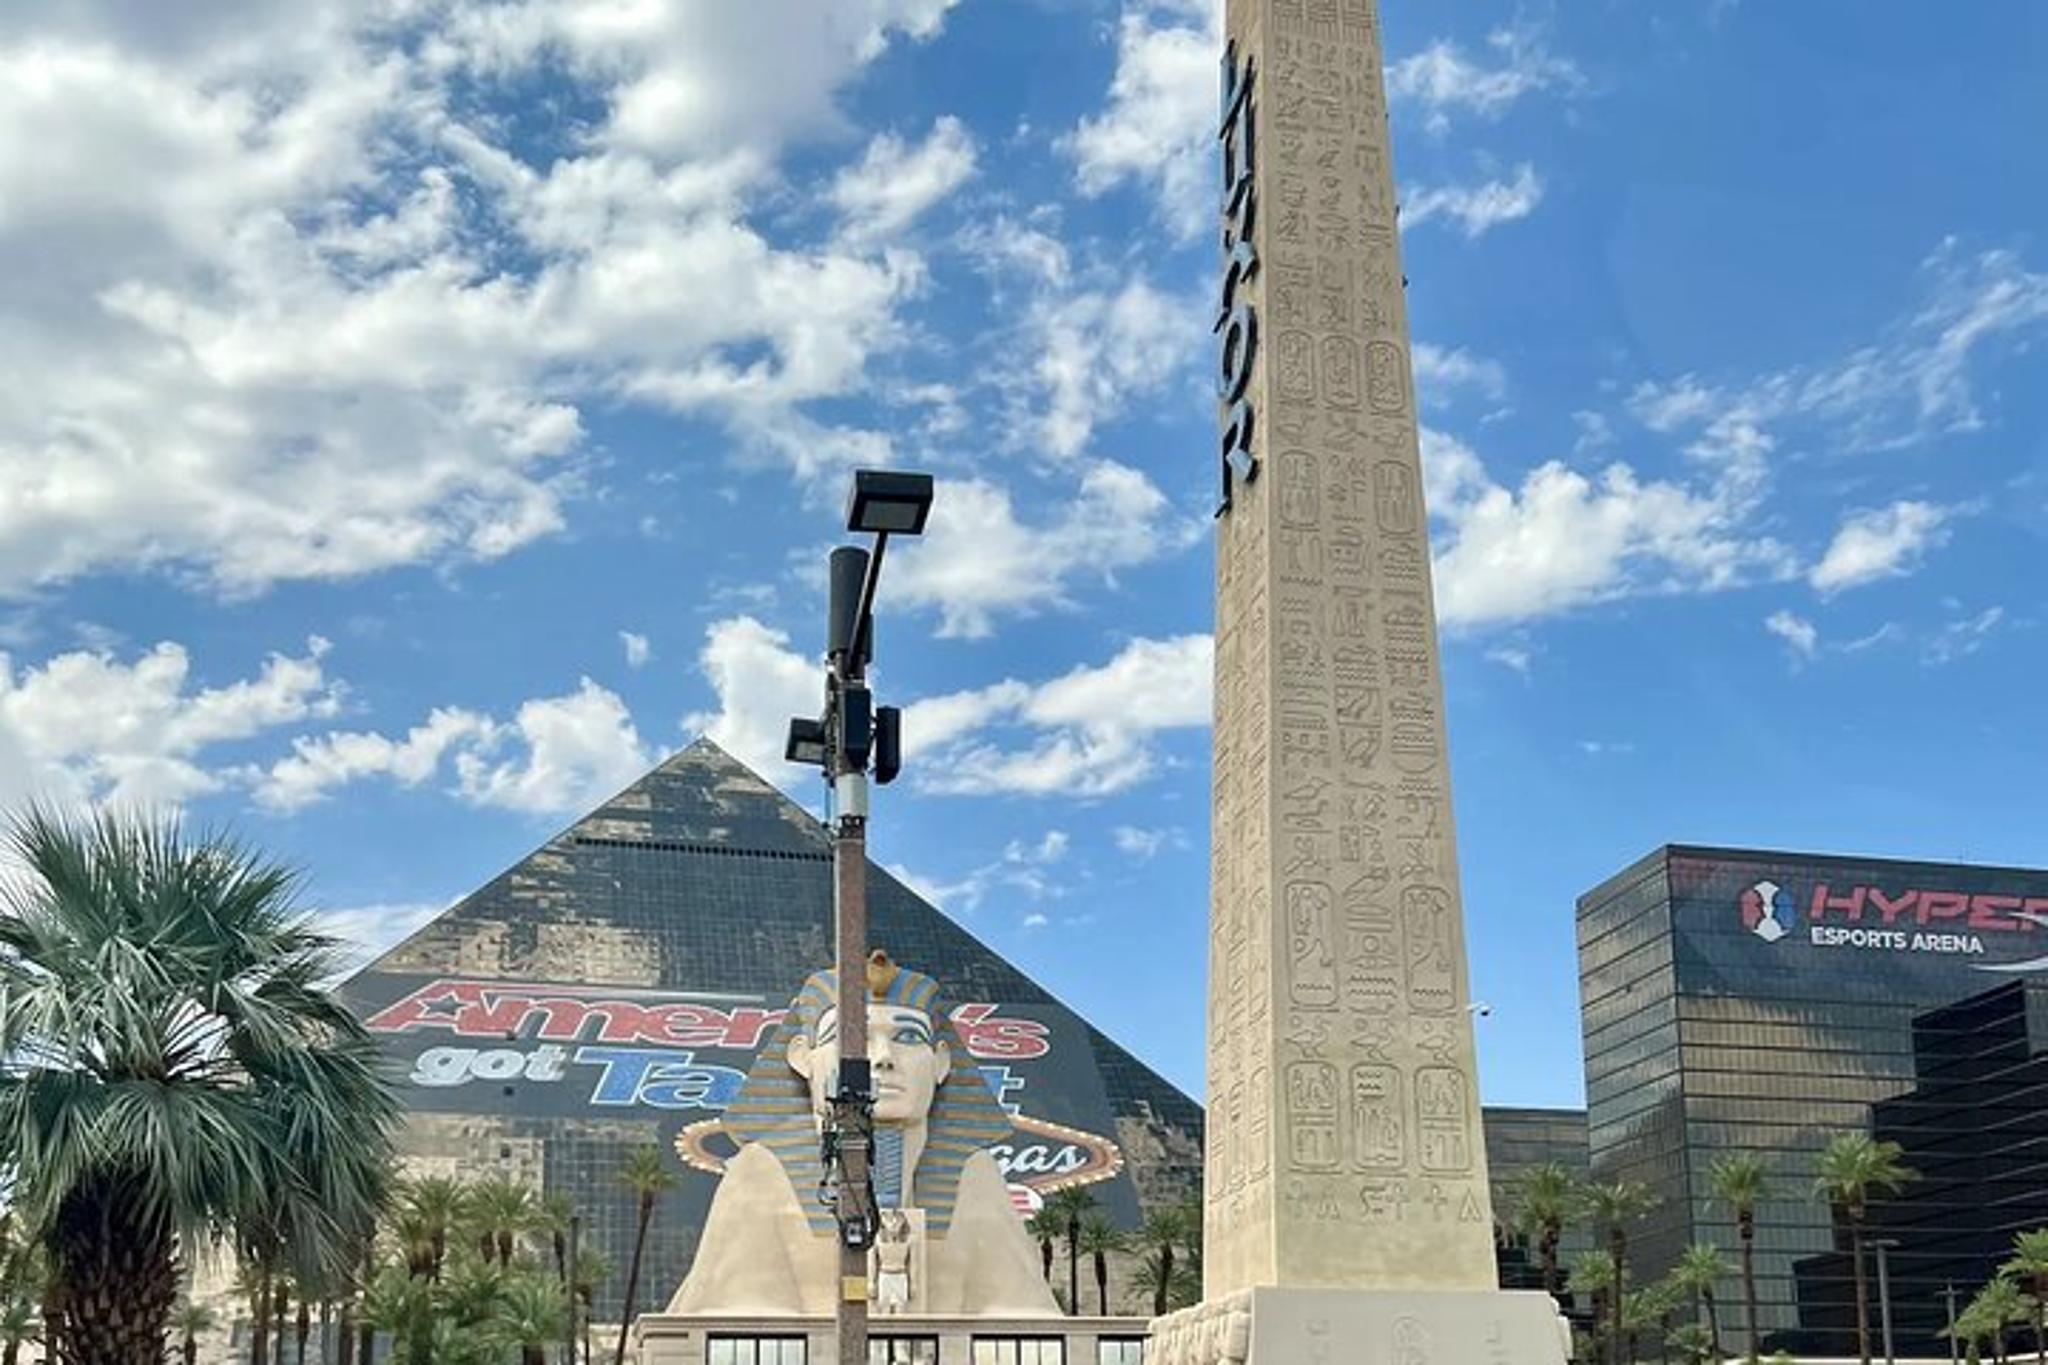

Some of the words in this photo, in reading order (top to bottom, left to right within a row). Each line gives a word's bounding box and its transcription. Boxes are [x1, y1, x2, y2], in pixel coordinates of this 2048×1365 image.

[1213, 37, 1261, 519] LUXOR
[1810, 926, 1906, 949] ESPORTS
[1911, 933, 1984, 954] ARENA
[409, 1043, 567, 1087] got
